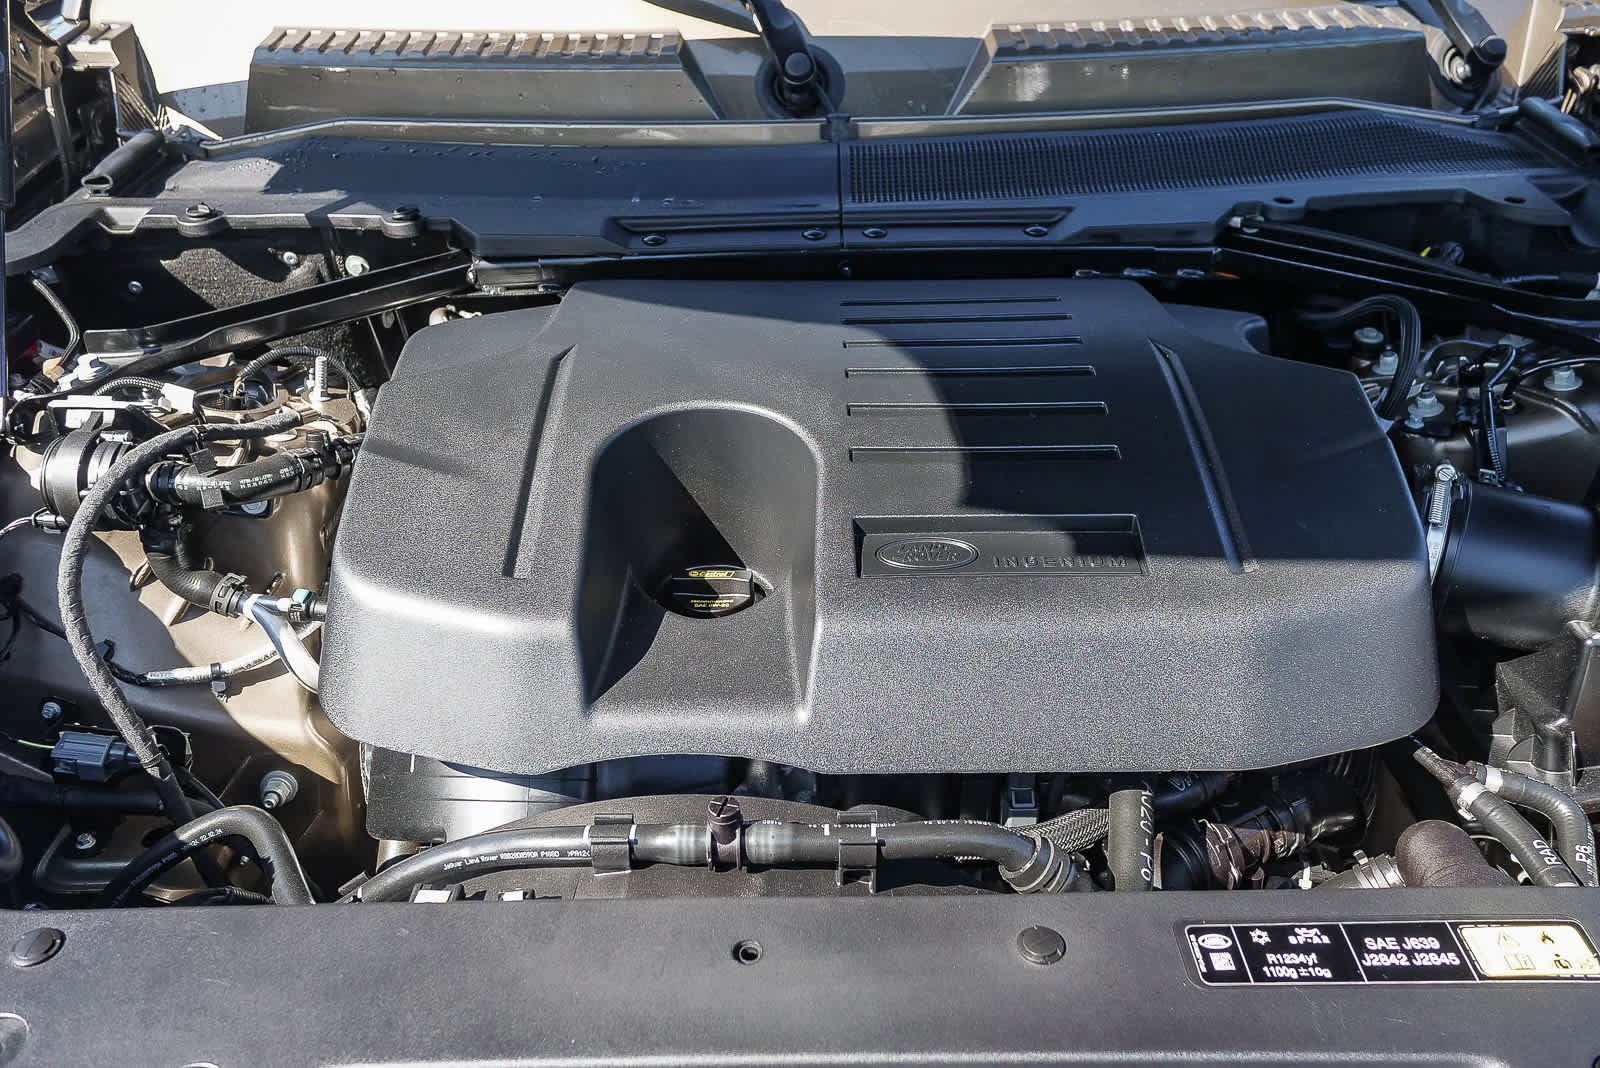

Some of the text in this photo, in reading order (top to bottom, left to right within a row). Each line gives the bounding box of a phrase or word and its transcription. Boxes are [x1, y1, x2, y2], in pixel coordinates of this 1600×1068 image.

[991, 555, 1129, 569] INGENIUM
[1532, 839, 1563, 866] RAD
[1364, 936, 1441, 950] SAE J639
[1265, 952, 1318, 966] R1234yf
